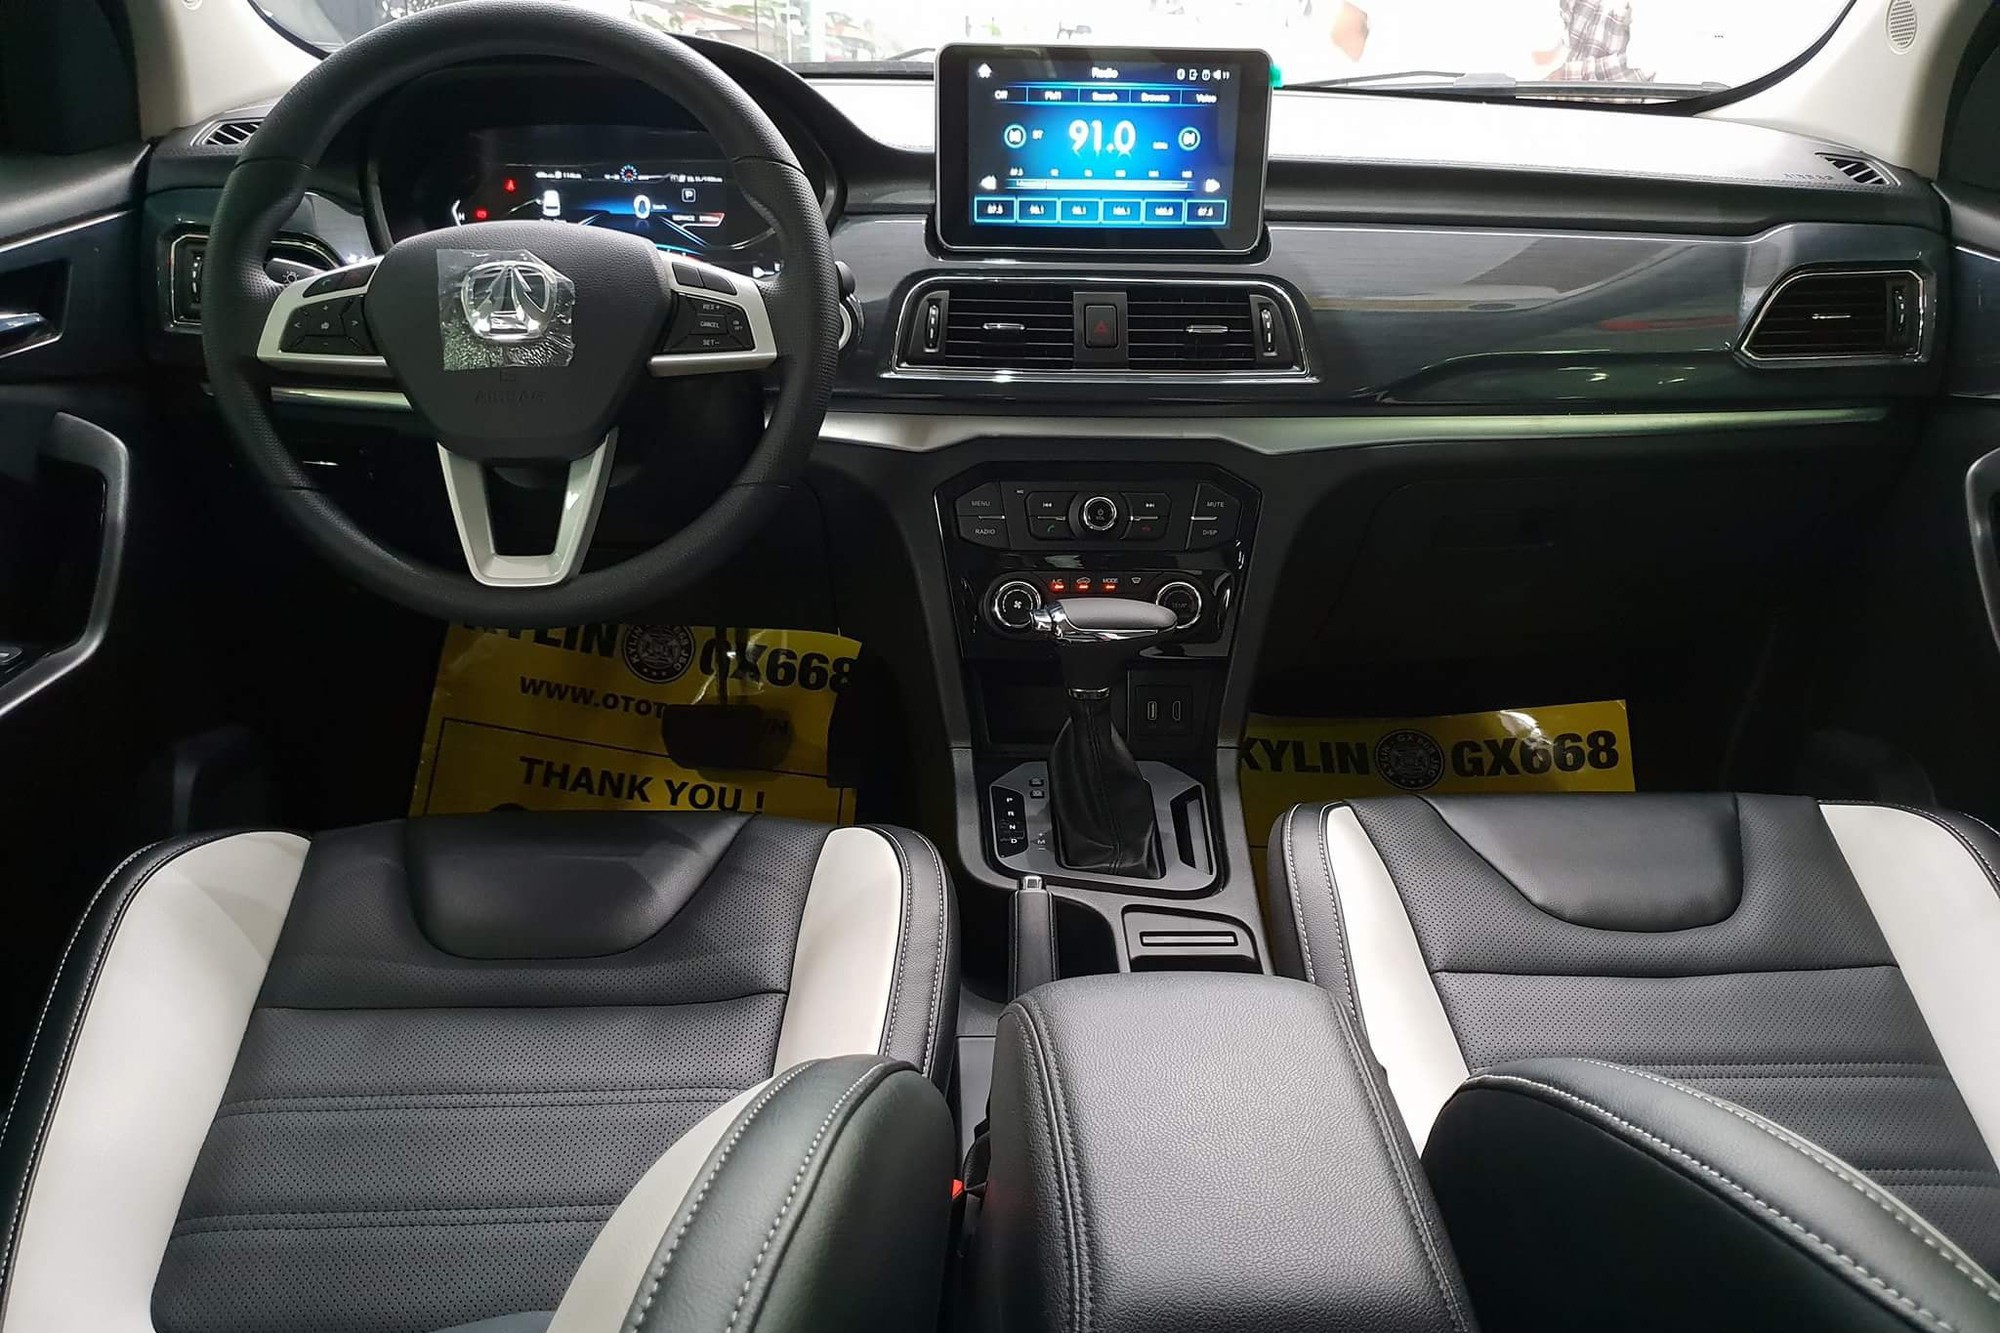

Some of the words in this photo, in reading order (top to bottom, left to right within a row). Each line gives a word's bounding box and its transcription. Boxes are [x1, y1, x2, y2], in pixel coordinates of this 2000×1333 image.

[1091, 66, 1119, 79] Radio
[1068, 118, 1136, 154] 91.0
[633, 194, 651, 220] 0
[700, 321, 720, 329] CANCEL
[975, 528, 996, 536] RADIO
[1451, 730, 1619, 778] GX668
[519, 756, 653, 804] THANK
[664, 778, 743, 812] YOU
[756, 791, 765, 810] !
